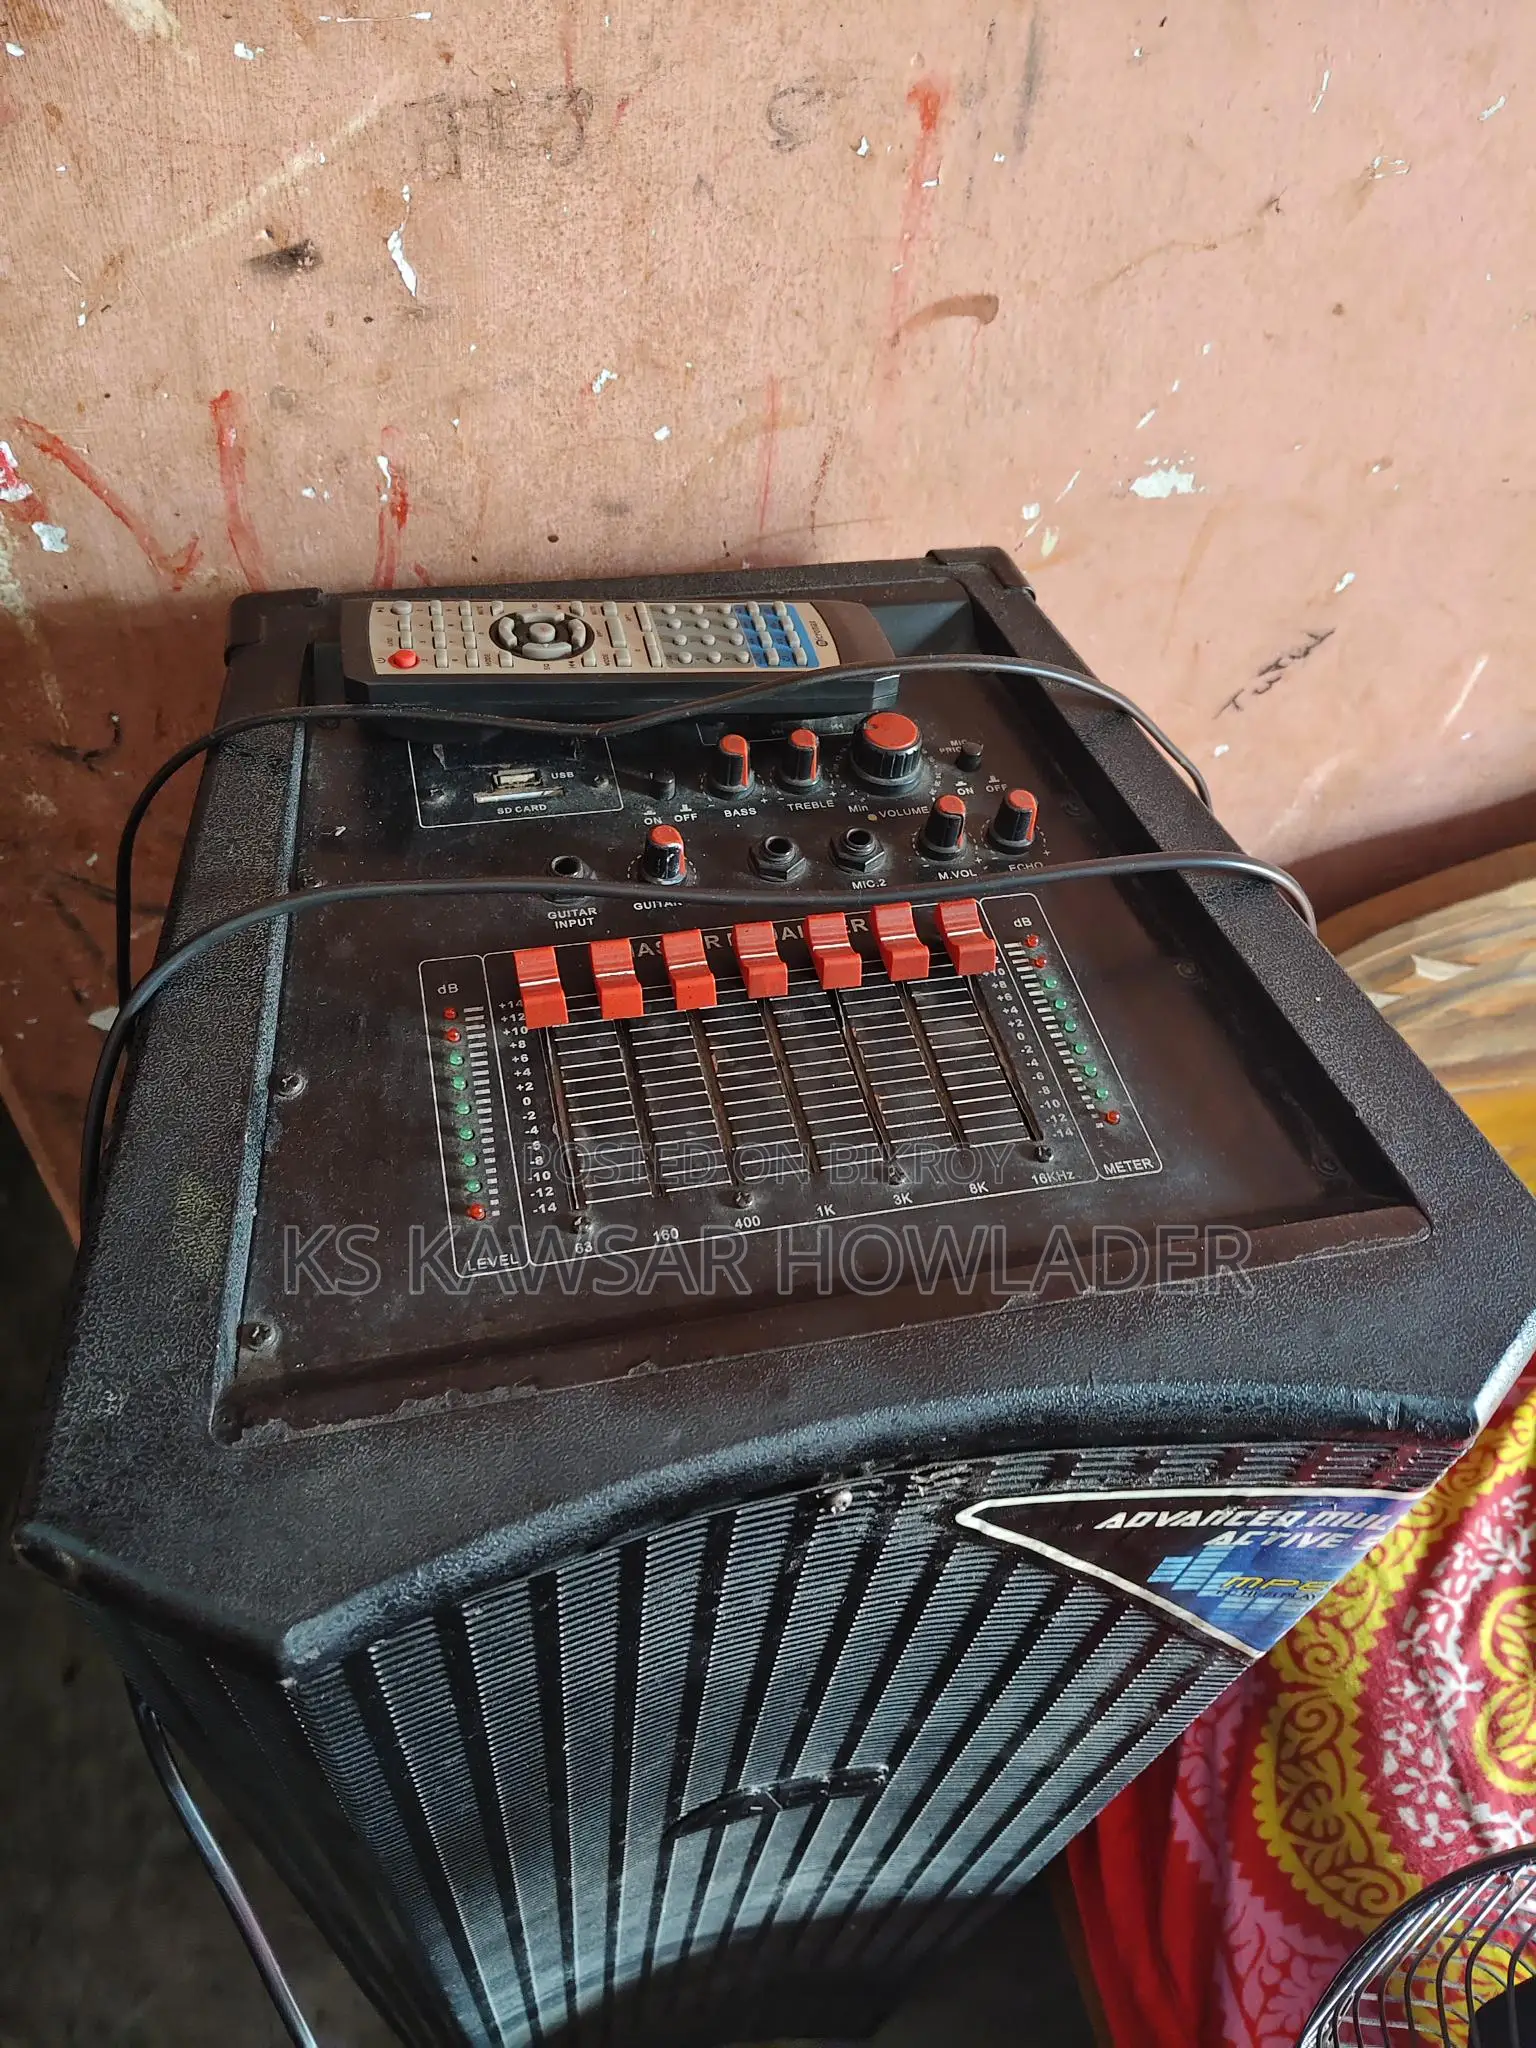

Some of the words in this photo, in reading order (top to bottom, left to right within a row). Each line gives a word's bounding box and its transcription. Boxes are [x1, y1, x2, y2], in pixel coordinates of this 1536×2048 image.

[551, 771, 574, 780] USB
[956, 786, 975, 796] ON
[985, 783, 1008, 793] OFF
[497, 807, 512, 815] SD
[514, 803, 548, 813] CARD
[787, 799, 835, 812] TREBLE
[847, 804, 869, 813] Min
[723, 807, 757, 818] BASS
[878, 805, 931, 818] VOLUME
[643, 816, 663, 826] ON
[674, 812, 698, 823] OFF
[937, 868, 978, 881] M.VOL
[851, 878, 888, 891] MIC.2
[547, 907, 598, 920] GUITAR
[554, 917, 595, 930] INPUT
[1013, 916, 1032, 928] dB
[437, 983, 459, 995] dB
[991, 980, 1007, 989] +8
[997, 993, 1013, 1002] +6
[1002, 1006, 1019, 1014] +4
[501, 1012, 526, 1022] +12
[1008, 1018, 1024, 1028] +2
[503, 1026, 529, 1036] +10
[1016, 1032, 1025, 1041] 0
[509, 1040, 527, 1049] +8
[1021, 1045, 1034, 1054] -2
[512, 1053, 529, 1063] +6
[1026, 1058, 1039, 1067] -4
[514, 1067, 532, 1077] +4
[1031, 1071, 1044, 1081] -6
[516, 1081, 534, 1092] +2
[1037, 1085, 1051, 1095] -8
[522, 1096, 532, 1106] 0
[1040, 1099, 1061, 1109] -10
[522, 1110, 537, 1120] -2
[1046, 1113, 1067, 1123] -12
[524, 1125, 539, 1135] -4
[1053, 1127, 1074, 1138] -14
[527, 1140, 541, 1151] -6
[529, 1155, 544, 1165] -8
[1103, 1157, 1155, 1175] METER
[528, 1171, 551, 1182] -10
[530, 1186, 555, 1198] -12
[533, 1202, 557, 1213] -14
[574, 1241, 593, 1254] 63
[653, 1227, 679, 1243] 160
[735, 1215, 761, 1230] 400
[816, 1203, 836, 1217] 1K
[892, 1191, 913, 1206] 3K
[969, 1180, 989, 1194] 8K
[1031, 1169, 1076, 1185] 16KHz
[467, 1253, 519, 1272] LEVEL
[1093, 1509, 1307, 1530] ADVANCED
[1203, 1530, 1354, 1548] ACTIVE
